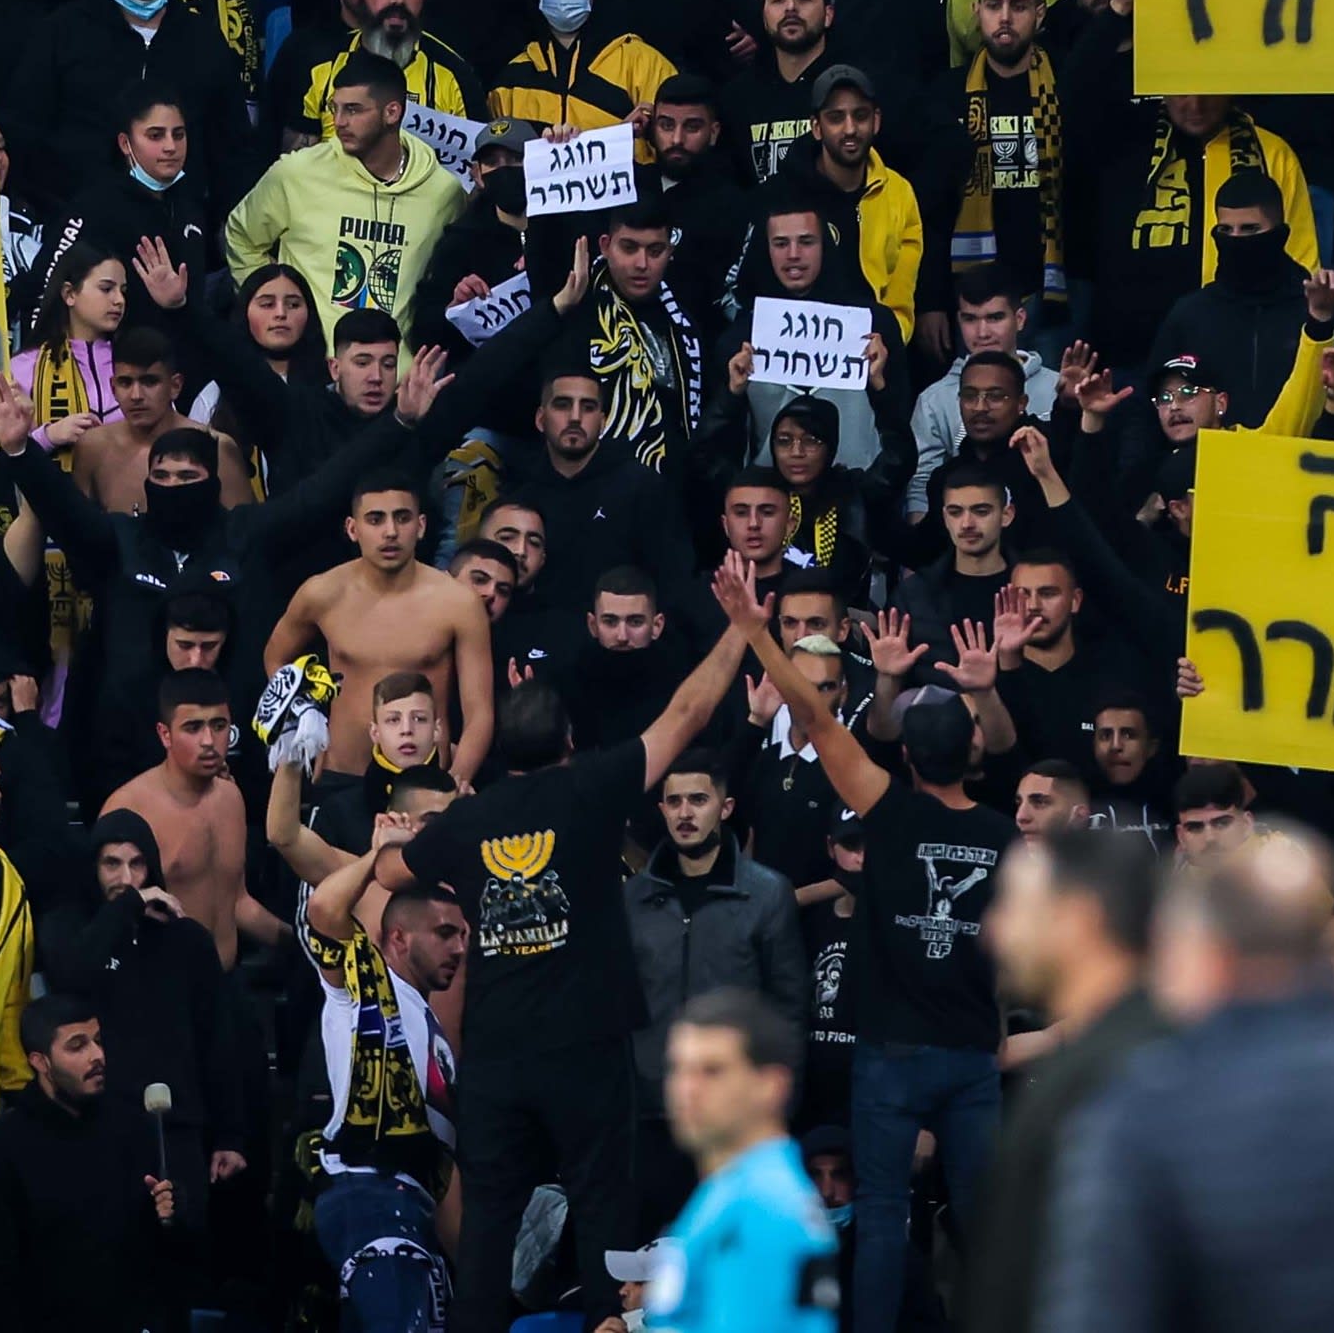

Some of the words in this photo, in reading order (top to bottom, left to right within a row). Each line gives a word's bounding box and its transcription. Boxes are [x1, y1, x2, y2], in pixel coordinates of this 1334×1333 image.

[406, 113, 468, 149] חוגג
[550, 140, 606, 171] חוגג
[531, 171, 632, 206] תשחרר
[338, 216, 406, 246] PUMA
[780, 312, 843, 341] חוגג
[754, 346, 864, 379] תשחרר
